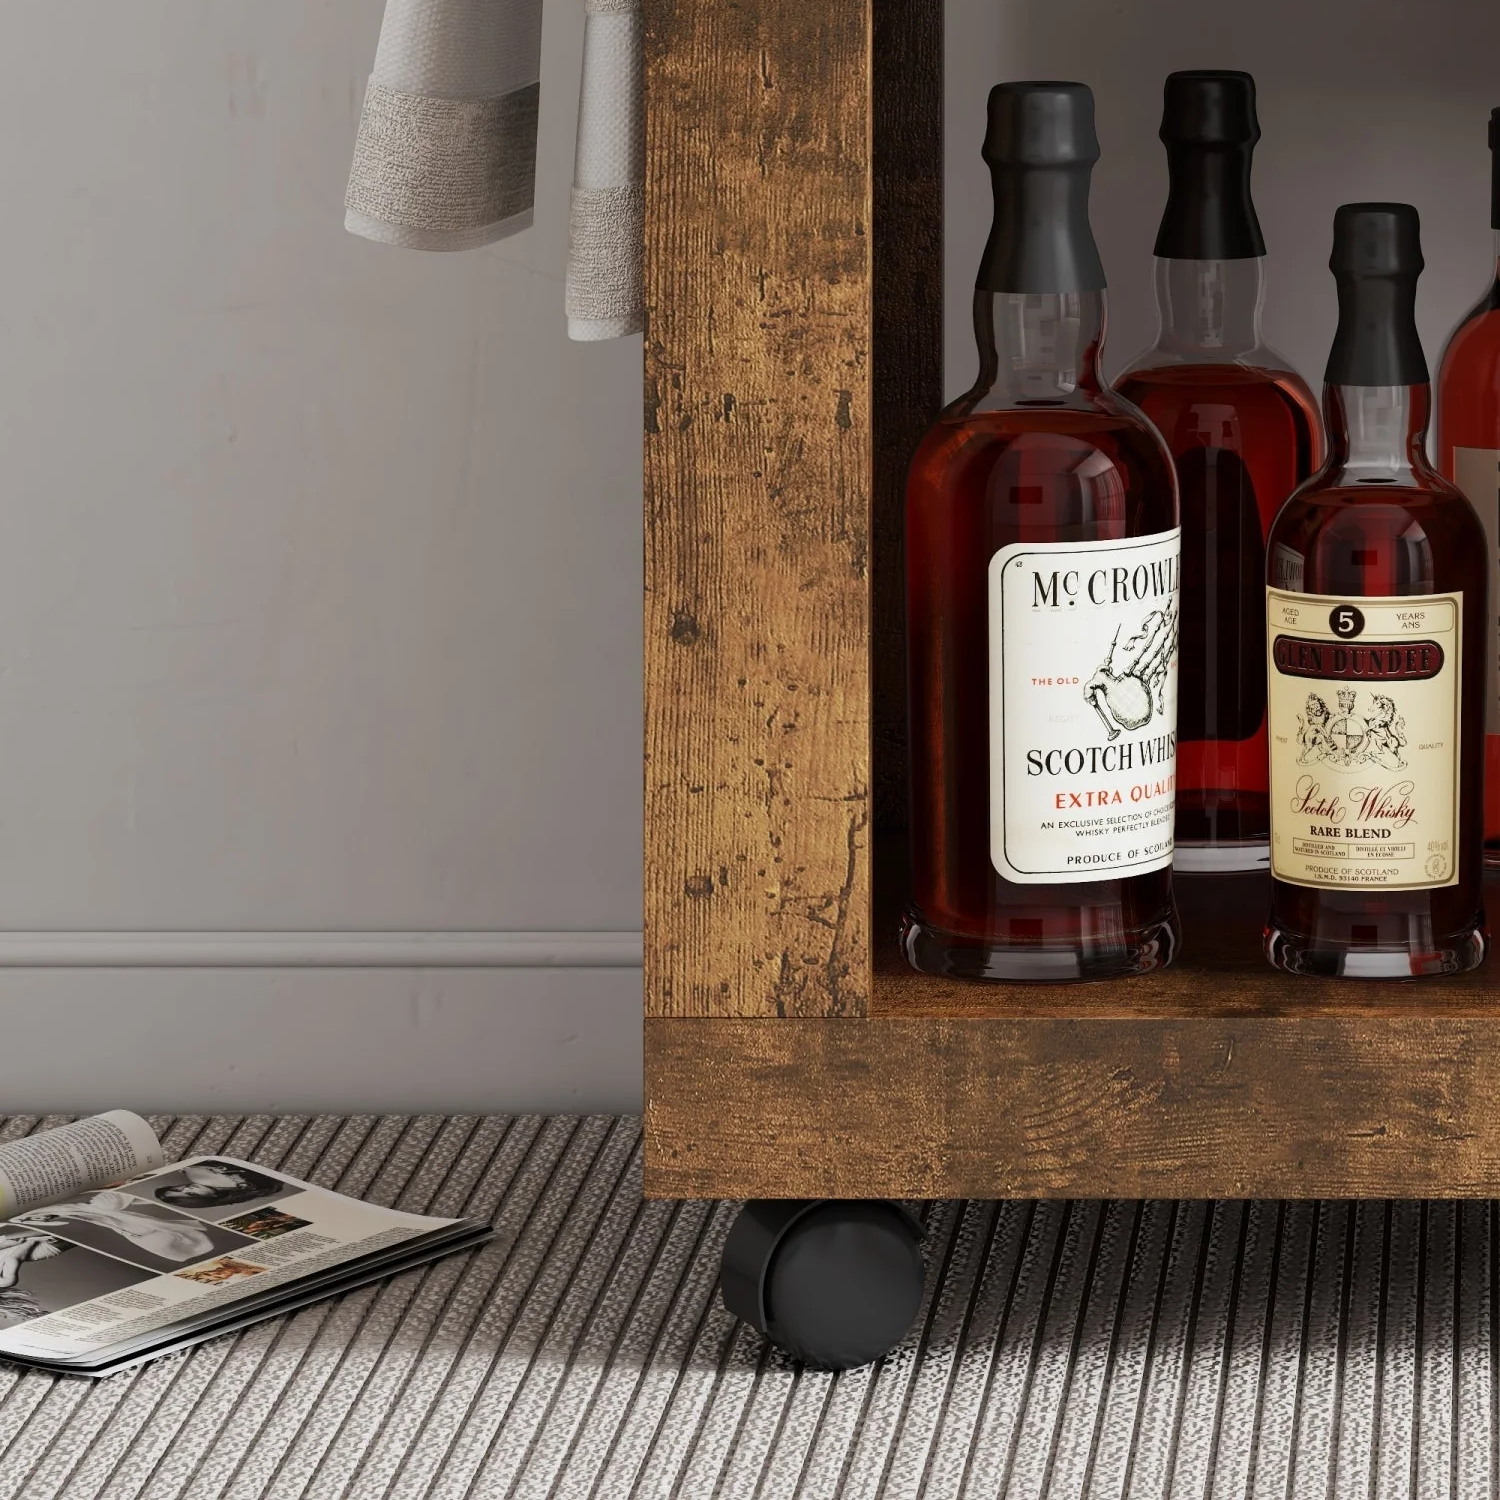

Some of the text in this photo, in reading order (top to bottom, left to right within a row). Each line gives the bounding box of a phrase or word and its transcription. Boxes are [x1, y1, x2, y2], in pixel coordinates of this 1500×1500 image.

[1282, 607, 1300, 616] AGED
[1396, 612, 1426, 621] YEARS
[1284, 616, 1297, 625] AGE
[1338, 612, 1355, 633] 5
[1401, 621, 1421, 629] ANS
[1276, 641, 1432, 675] GLEN DUNDEE
[1032, 677, 1079, 686] THE OLD
[1418, 742, 1444, 750] QUALITY
[1026, 731, 1177, 776] SCOTCH WHIS
[1055, 789, 1122, 809] EXTRA
[1290, 775, 1419, 829] Scotch Whisky
[1058, 818, 1103, 829] EXCLUSIVE
[1106, 813, 1143, 825] SELECTION
[1075, 828, 1110, 837] WHISKY
[1113, 822, 1149, 834] PERFECTLY
[1310, 825, 1391, 839] RARE BLEND
[1067, 852, 1121, 865] PRODUCE
[1127, 848, 1140, 859] OF
[1305, 864, 1399, 876] PRODUCE OF SCOTLAND
